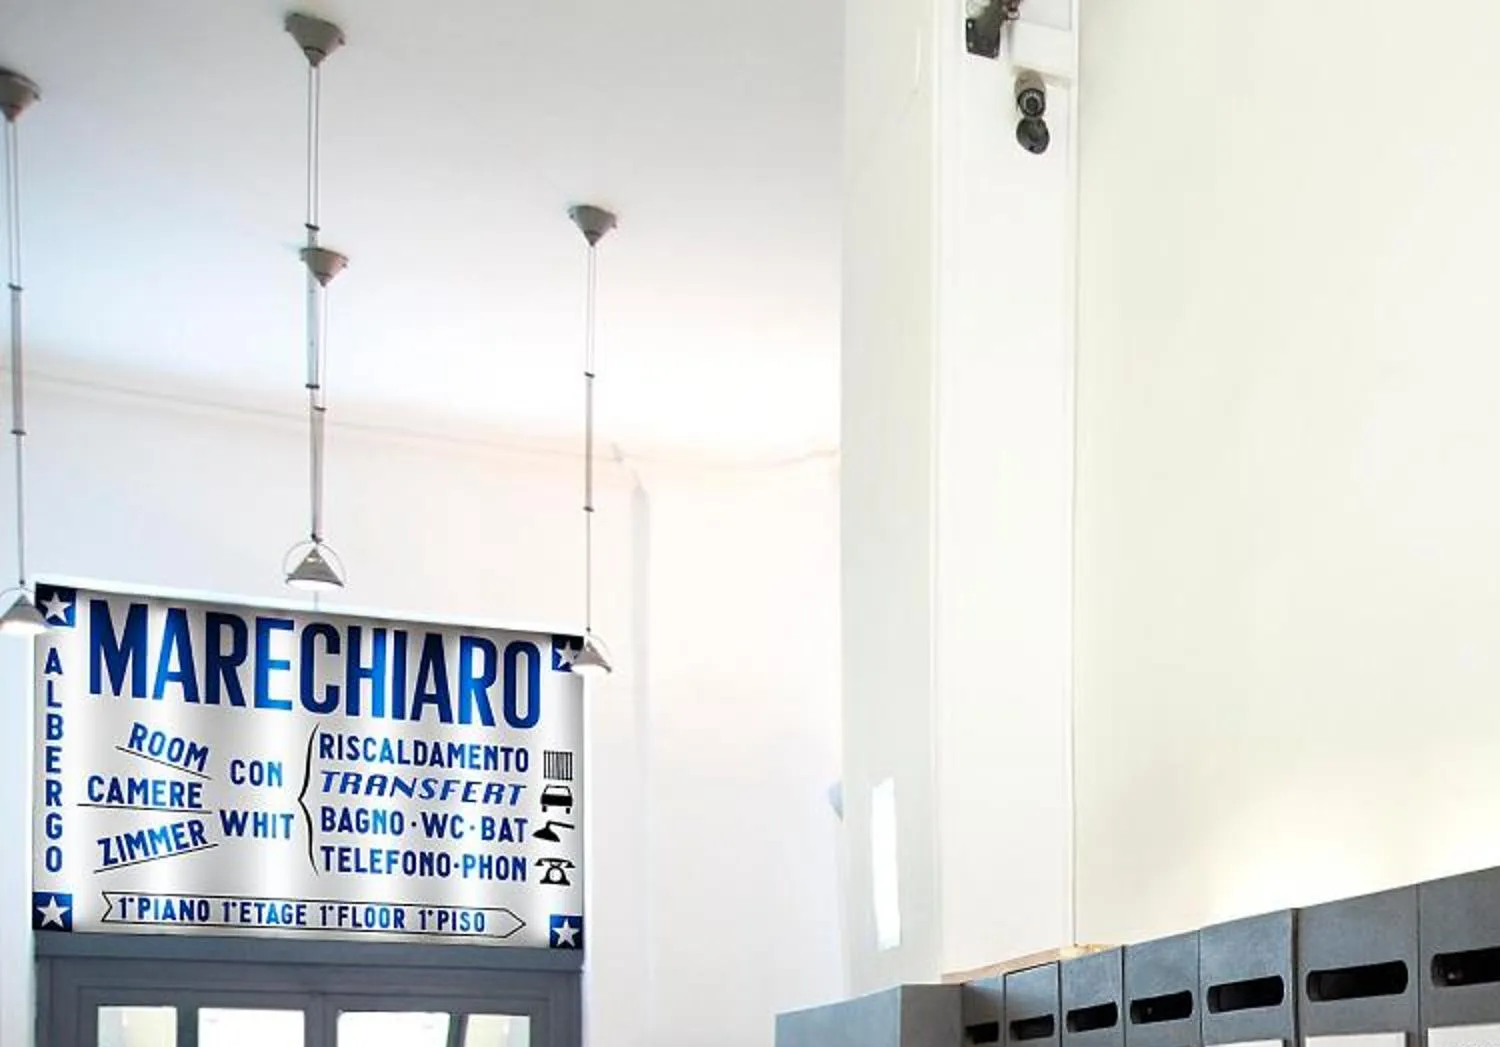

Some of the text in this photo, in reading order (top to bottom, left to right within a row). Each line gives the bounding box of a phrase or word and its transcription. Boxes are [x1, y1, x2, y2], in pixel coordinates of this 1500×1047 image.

[89, 599, 541, 729] MARECHIARO
[45, 647, 64, 873] ALBERGO
[127, 722, 210, 772] ROOM
[319, 733, 529, 773] RISCALDAMENTO
[87, 775, 203, 808] CAMERE
[230, 759, 283, 787] CON
[319, 770, 528, 805] TRANSFERT
[97, 819, 208, 866] ZIMMER
[219, 809, 295, 840] WHIT
